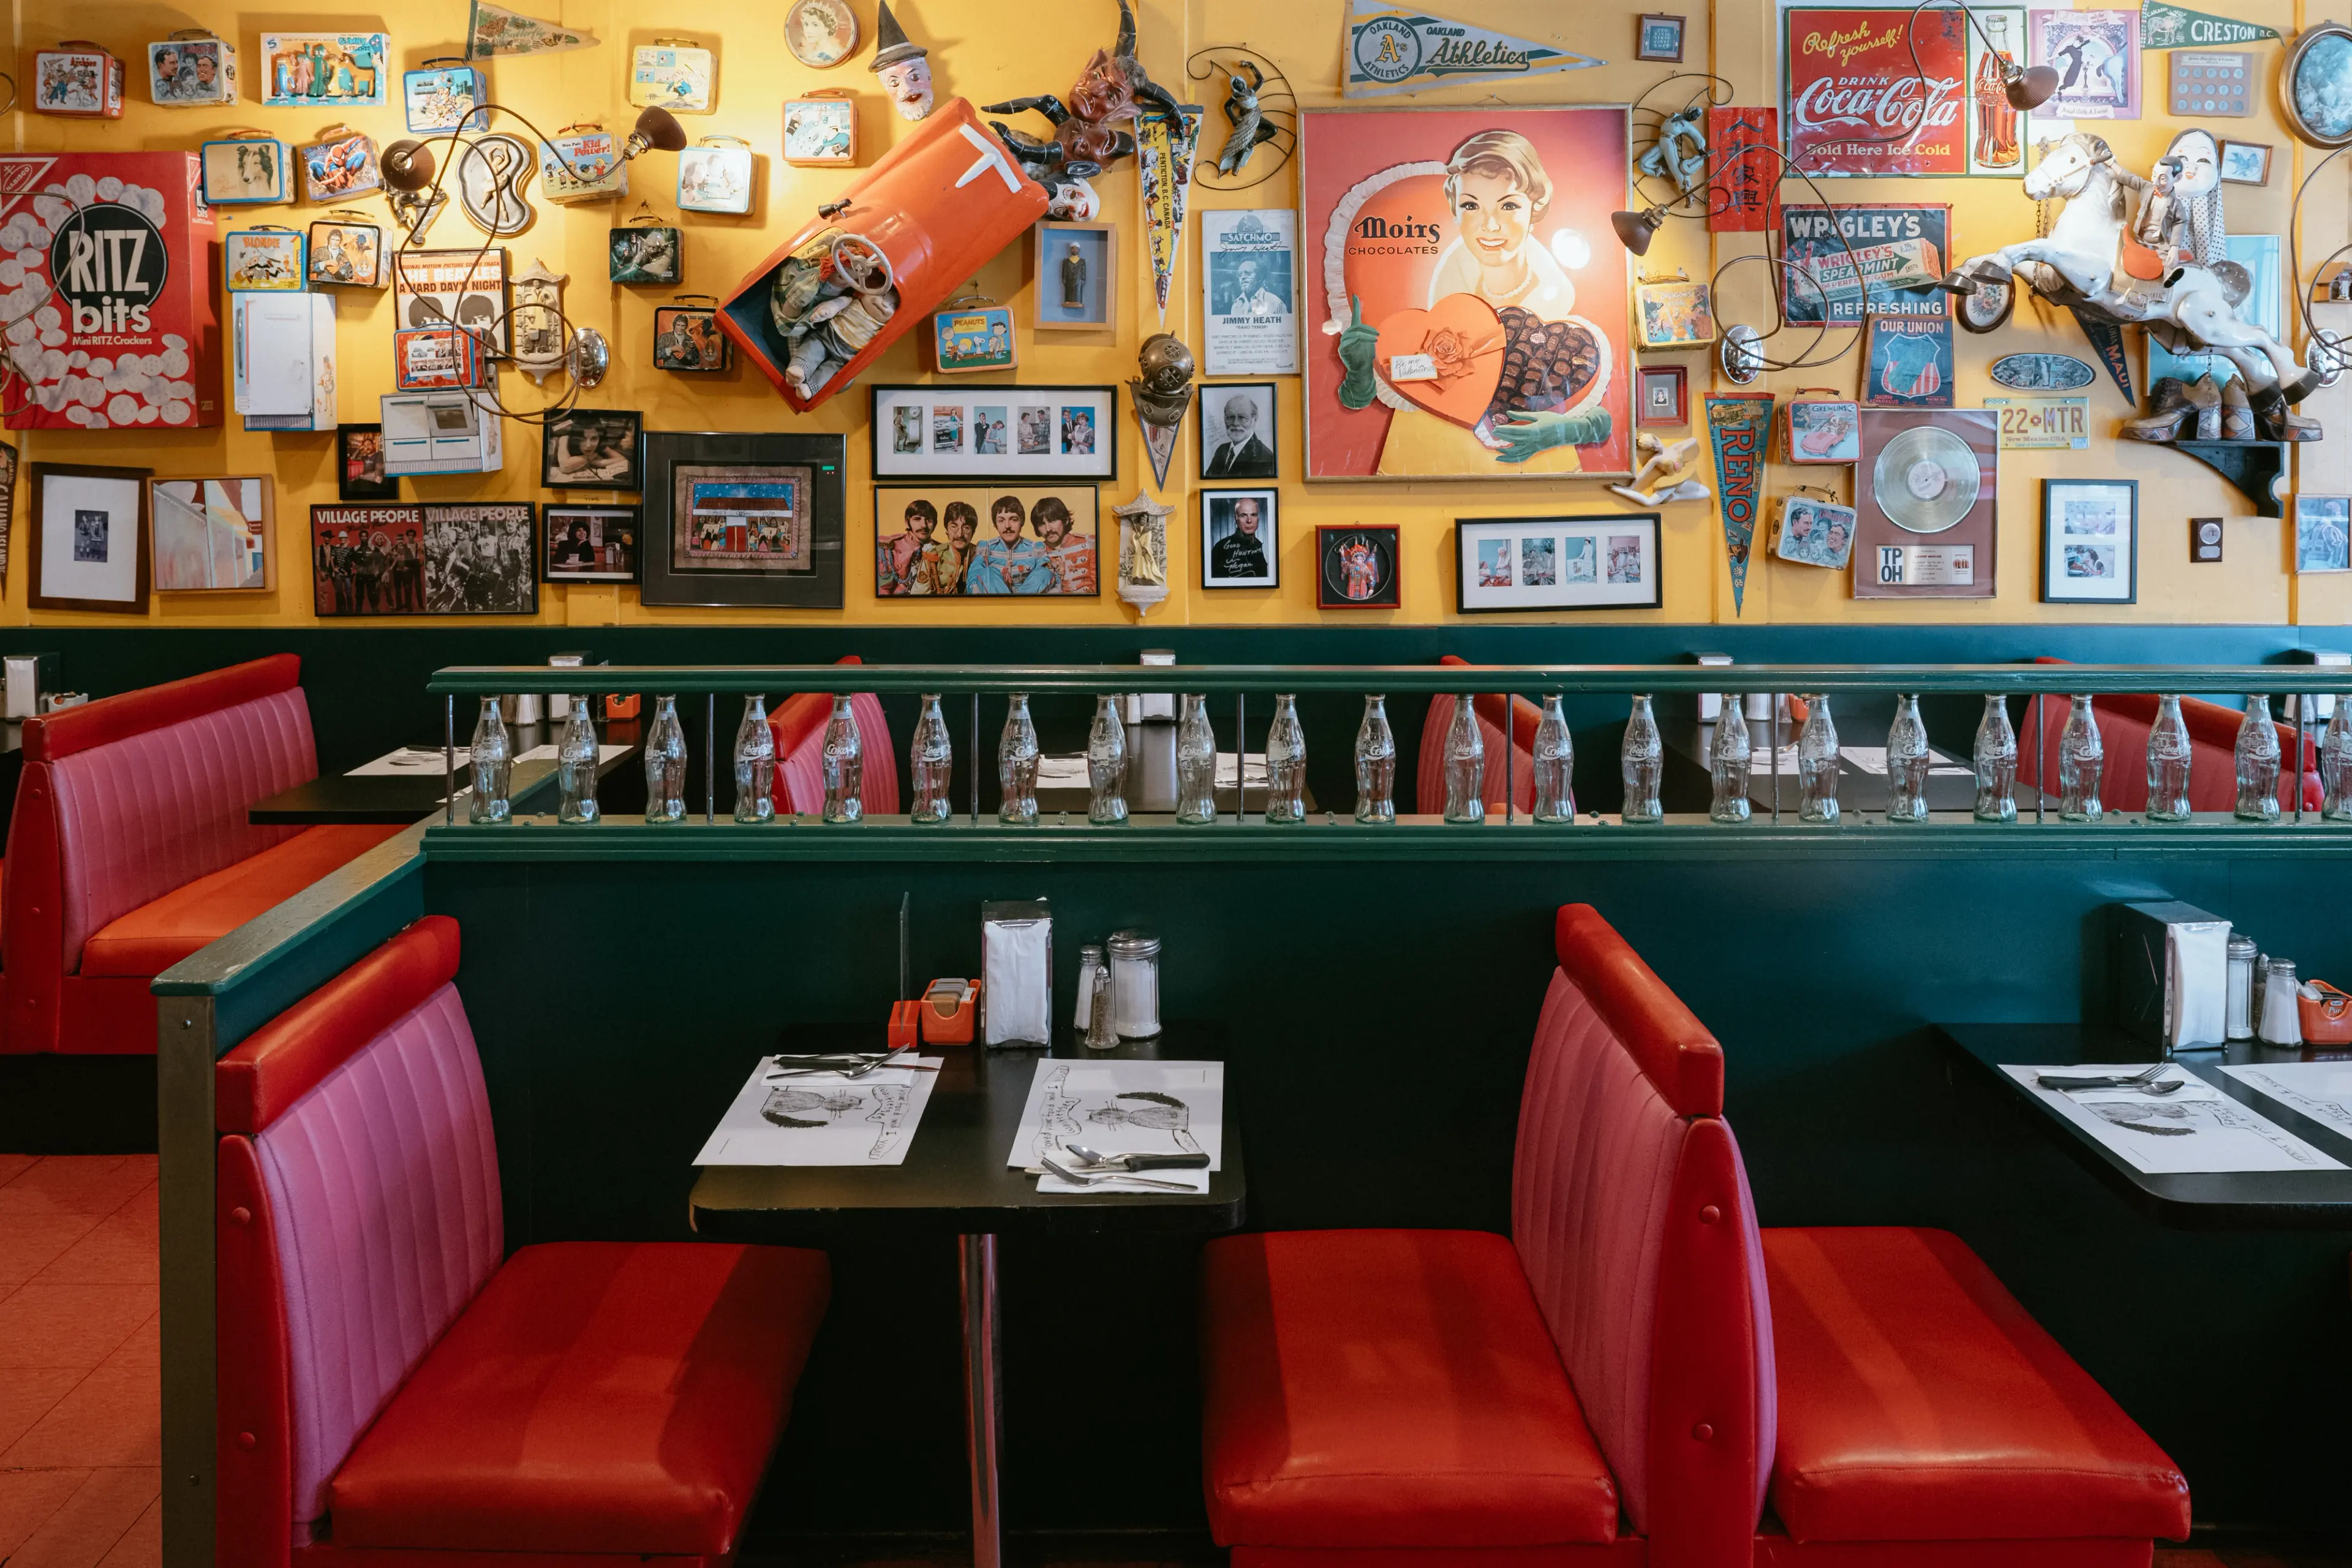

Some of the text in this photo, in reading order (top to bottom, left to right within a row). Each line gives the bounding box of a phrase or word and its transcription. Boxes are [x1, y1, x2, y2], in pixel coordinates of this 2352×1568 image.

[2146, 7, 2168, 17] CANADA
[1369, 21, 1411, 40] OAKLAND
[1427, 26, 1465, 37] OAKLAND
[2191, 20, 2256, 42] CRESTON
[338, 37, 366, 46] GUMBY
[1803, 21, 1871, 58] Refresh
[1840, 24, 1904, 67] yourself!
[1375, 34, 1408, 63] A's
[1426, 37, 1530, 66] Athletics
[1364, 61, 1409, 78] ATHLETICS
[1838, 77, 1890, 86] DRINK
[1795, 76, 1964, 127] Coca-Cola
[573, 144, 611, 156] Power!
[583, 139, 601, 149] Kid
[1806, 143, 1950, 156] Sold Here Ice Cold
[6, 166, 31, 191] NABISCO
[1159, 153, 1169, 189] PENTICTON,
[1354, 215, 1441, 244] Moirs
[1790, 212, 1921, 238] WRIGLEY'S
[243, 236, 280, 248] BLONDIE
[1348, 246, 1439, 255] CHOCOLATES
[1818, 246, 1893, 269] WRIGLEY'S
[69, 229, 149, 292] RITZ
[1905, 264, 1919, 273] LASTS
[399, 284, 406, 293] A
[472, 280, 501, 290] NIGHT
[72, 296, 151, 333] bits
[1834, 302, 1942, 315] REFRESHING
[1880, 320, 1943, 333] OUR UNION
[72, 336, 152, 345] Mini RITZ Crackers
[1395, 359, 1404, 369] Be
[2106, 344, 2130, 388] MAUI
[2003, 407, 2084, 434] 22 MTR
[1719, 429, 1755, 523] RENO
[317, 510, 419, 523] VILLAGE PEOPLE
[427, 506, 529, 521] VILLAGE PEOPLE
[1223, 539, 1240, 549] GOOD
[1882, 548, 1902, 564] TP
[1881, 565, 1902, 582] OH
[1181, 745, 1202, 756] Coke
